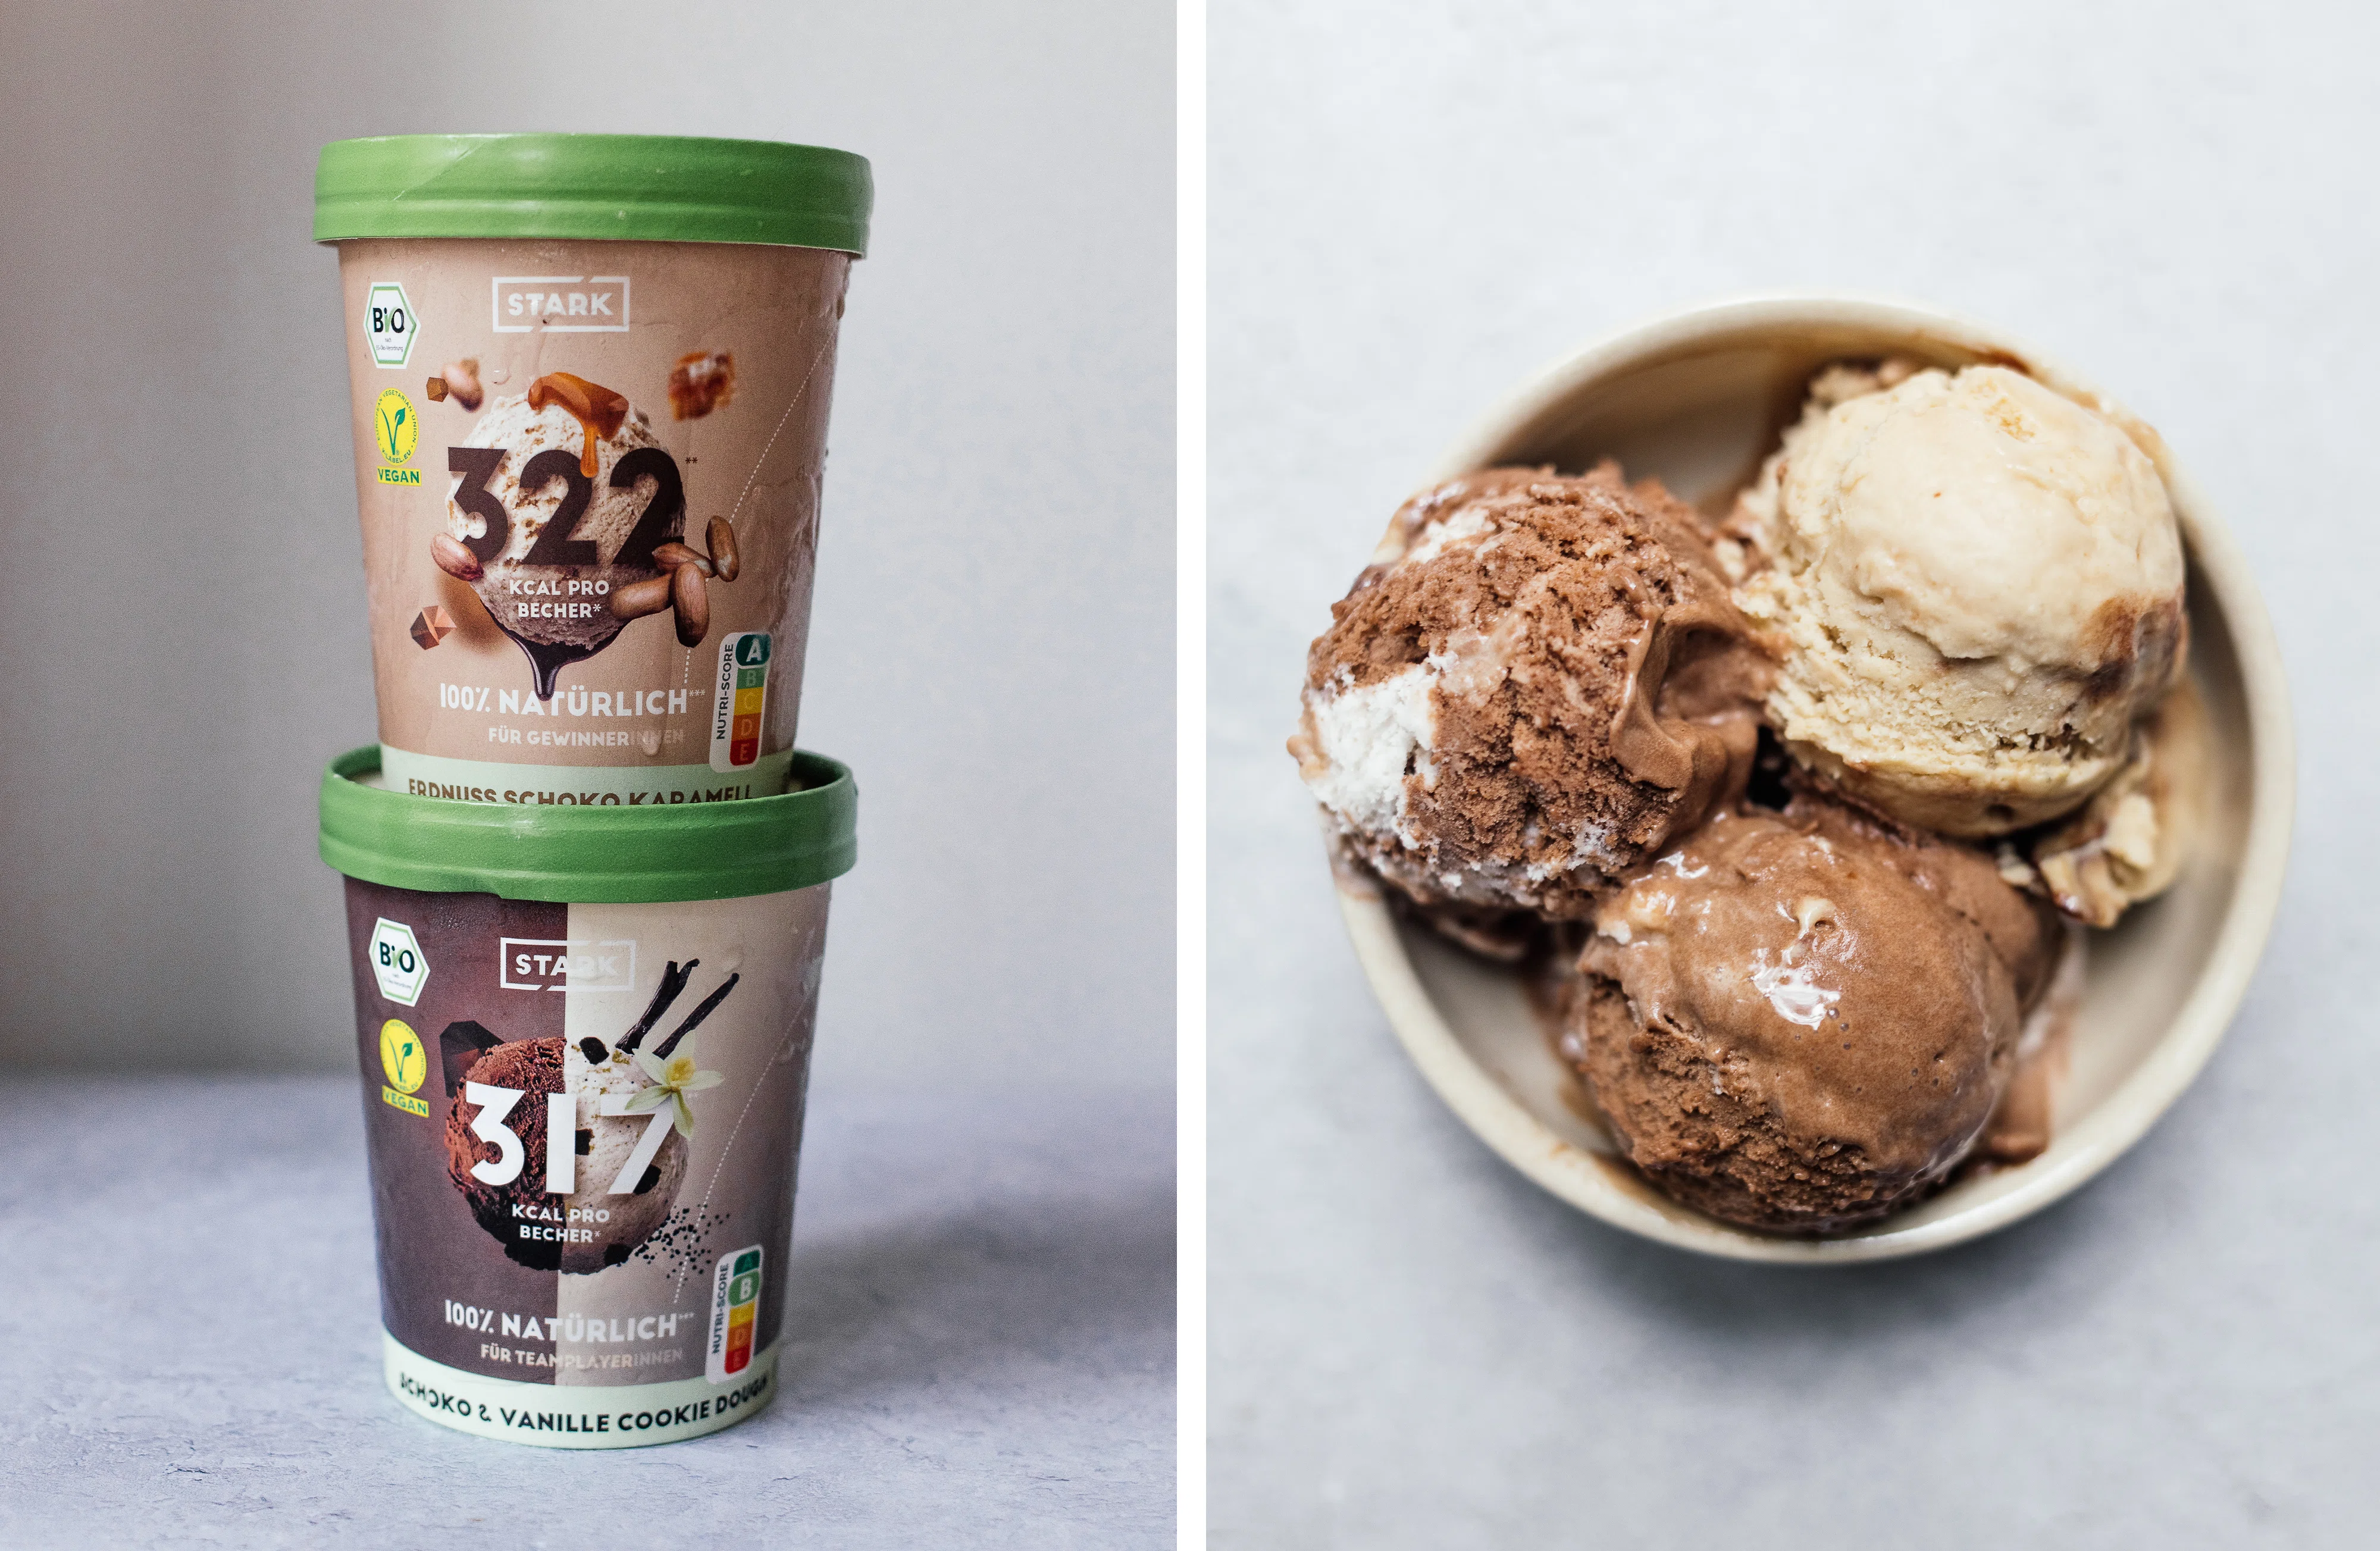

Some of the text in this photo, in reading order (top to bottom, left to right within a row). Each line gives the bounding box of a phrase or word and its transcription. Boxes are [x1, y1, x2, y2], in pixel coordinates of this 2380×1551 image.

[508, 293, 613, 316] STARK
[383, 390, 412, 412] VEGETARIAN
[378, 468, 420, 484] VEGAN
[509, 579, 609, 595] KCAL PRO
[746, 638, 762, 662] A
[440, 683, 490, 712] 100%
[716, 644, 734, 740] NUTRI-SCORE
[488, 725, 522, 744] FÜR
[515, 953, 619, 976] STARK
[385, 1090, 427, 1115] VEGAN
[512, 1203, 610, 1223] KCAL PRO
[740, 1277, 751, 1300] B
[445, 1299, 494, 1333] 100%
[711, 1262, 729, 1354] NUTRI-SCORE
[481, 1342, 511, 1362] FÜR
[499, 1407, 610, 1432] VANILLE
[618, 1399, 710, 1431] COOKIE
